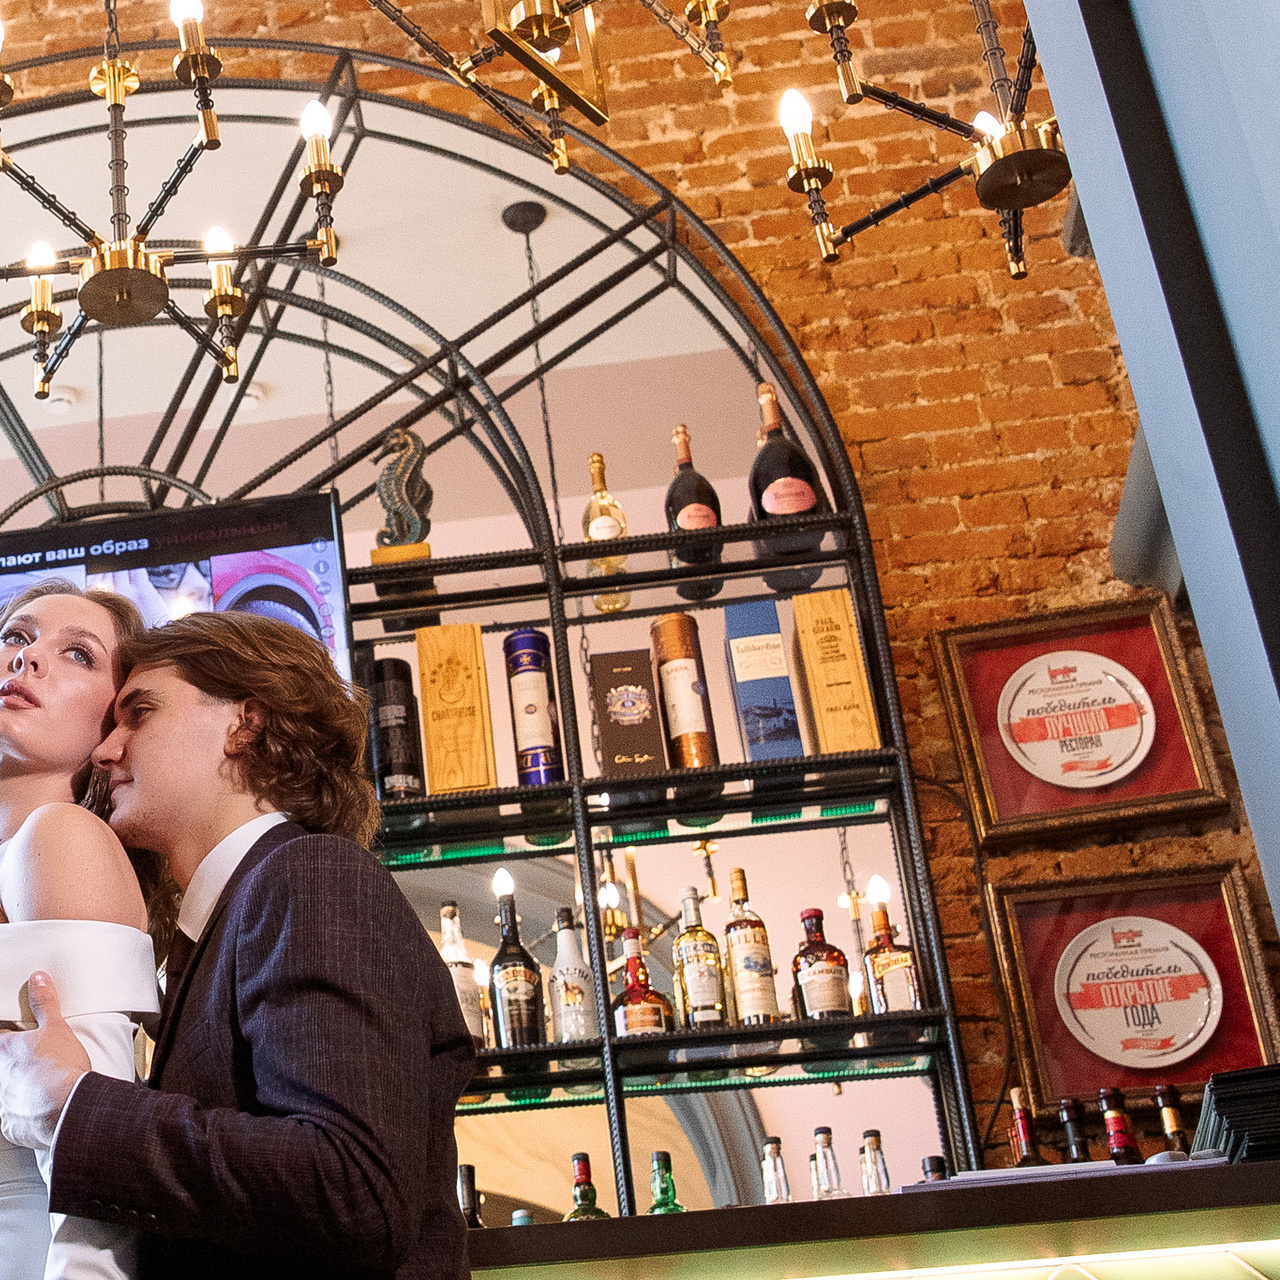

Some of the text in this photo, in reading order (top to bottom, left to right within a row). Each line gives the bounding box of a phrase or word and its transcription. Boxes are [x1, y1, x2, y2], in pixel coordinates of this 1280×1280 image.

[45, 546, 86, 563] ваш
[89, 537, 150, 557] образ
[1026, 696, 1117, 717] победитель
[1059, 735, 1104, 754] РЕСТОРАН
[1085, 963, 1183, 982] победитель
[1099, 978, 1175, 1007] ОТКРЫТИЕ
[1123, 1004, 1162, 1029] ГОДА
